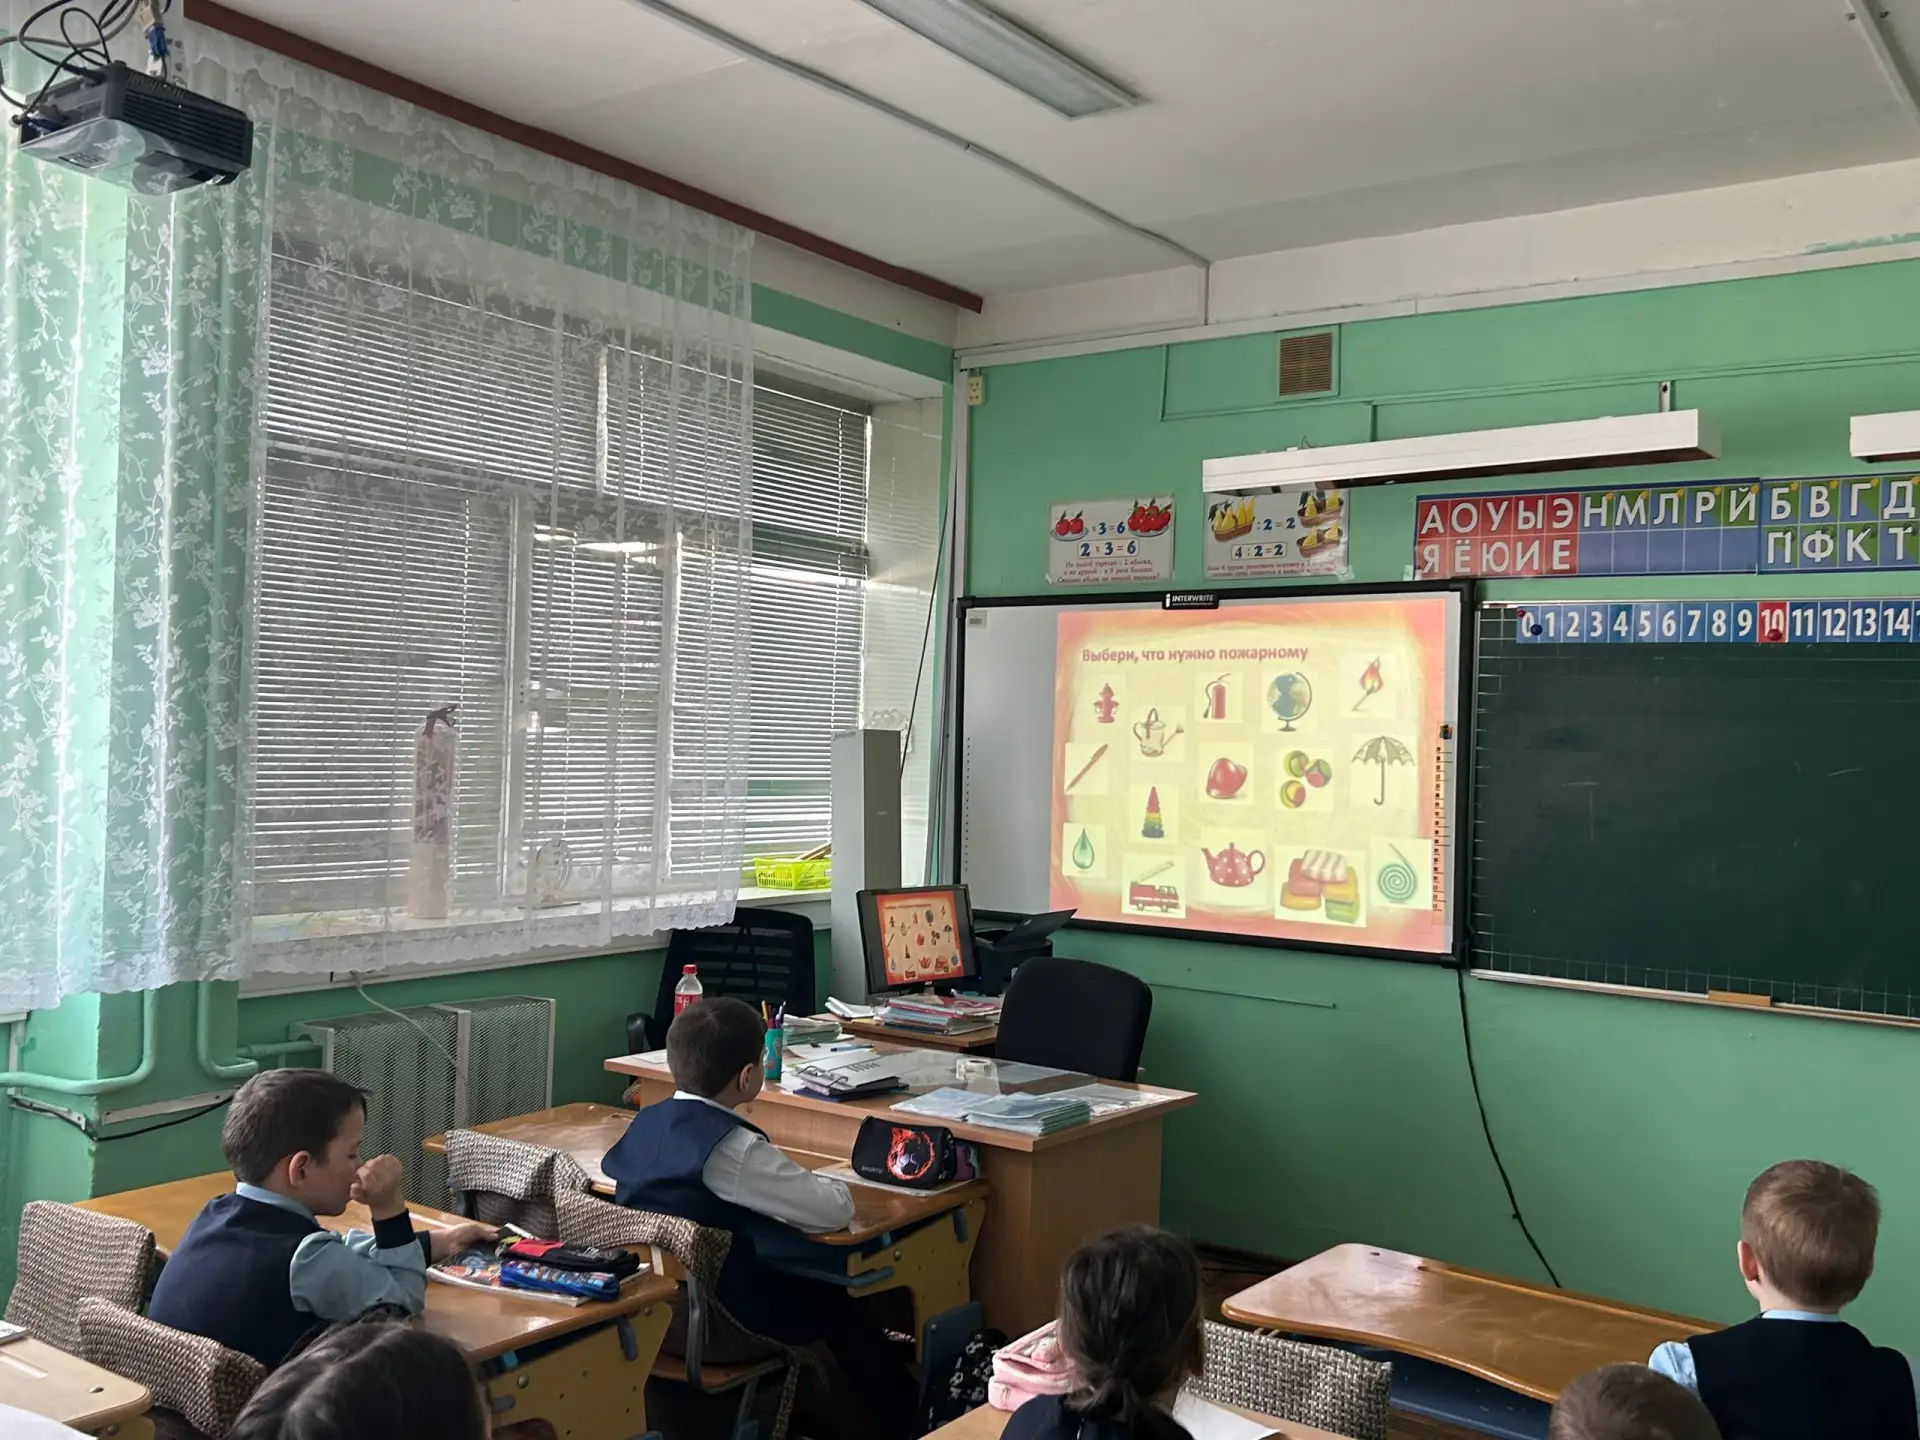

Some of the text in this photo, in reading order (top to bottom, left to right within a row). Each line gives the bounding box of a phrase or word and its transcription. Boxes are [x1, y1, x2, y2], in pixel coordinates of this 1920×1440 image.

[1172, 594, 1214, 602] INTERWRITE
[1521, 612, 1535, 637] 0
[1545, 612, 1555, 637] 1
[1566, 611, 1580, 637] 2
[1590, 611, 1603, 637] 3
[1613, 611, 1628, 637] 4
[1638, 610, 1651, 637] 5
[1662, 610, 1676, 637] 6
[1688, 610, 1701, 637] 7
[1712, 609, 1727, 637] 8
[1738, 609, 1752, 637] 9
[1761, 609, 1784, 637] 10
[1792, 609, 1813, 637] 11
[1822, 608, 1846, 636] 12
[1853, 608, 1877, 636] 13
[1883, 608, 1910, 636] 14
[1082, 647, 1309, 664] Выбери, что нужно пожарному
